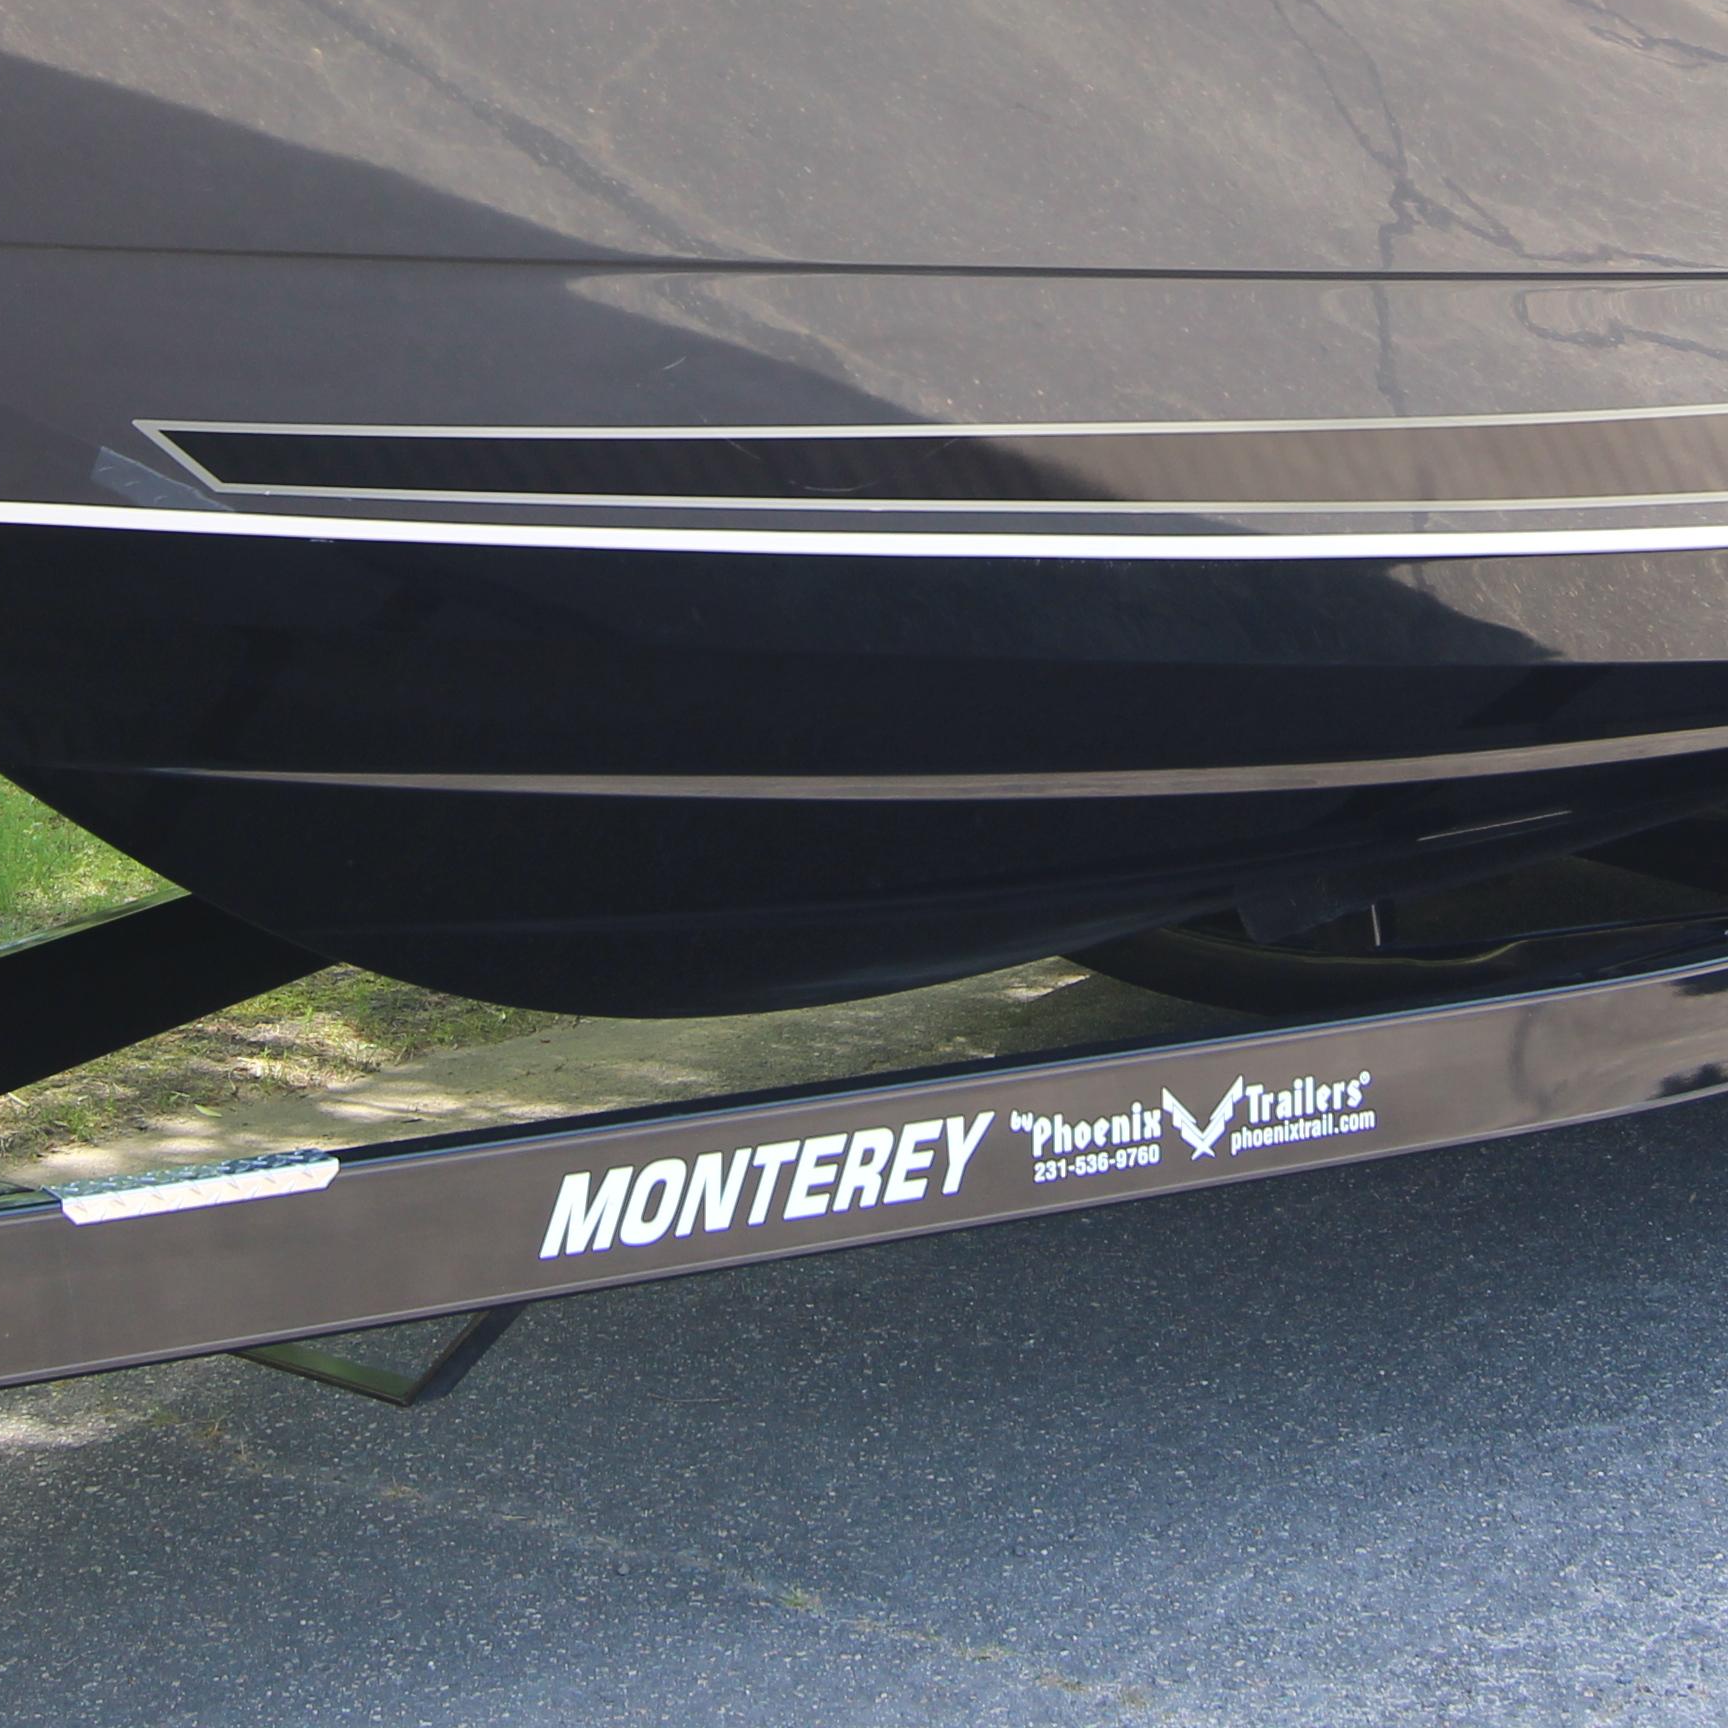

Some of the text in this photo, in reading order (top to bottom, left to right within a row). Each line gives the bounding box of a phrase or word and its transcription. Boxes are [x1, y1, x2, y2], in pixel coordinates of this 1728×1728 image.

[1032, 1101, 1162, 1159] Phoenix
[1231, 1110, 1376, 1156] phoenixtrail.com
[538, 1110, 996, 1260] MONTEREY
[1034, 1143, 1161, 1183] 231-536-9760
